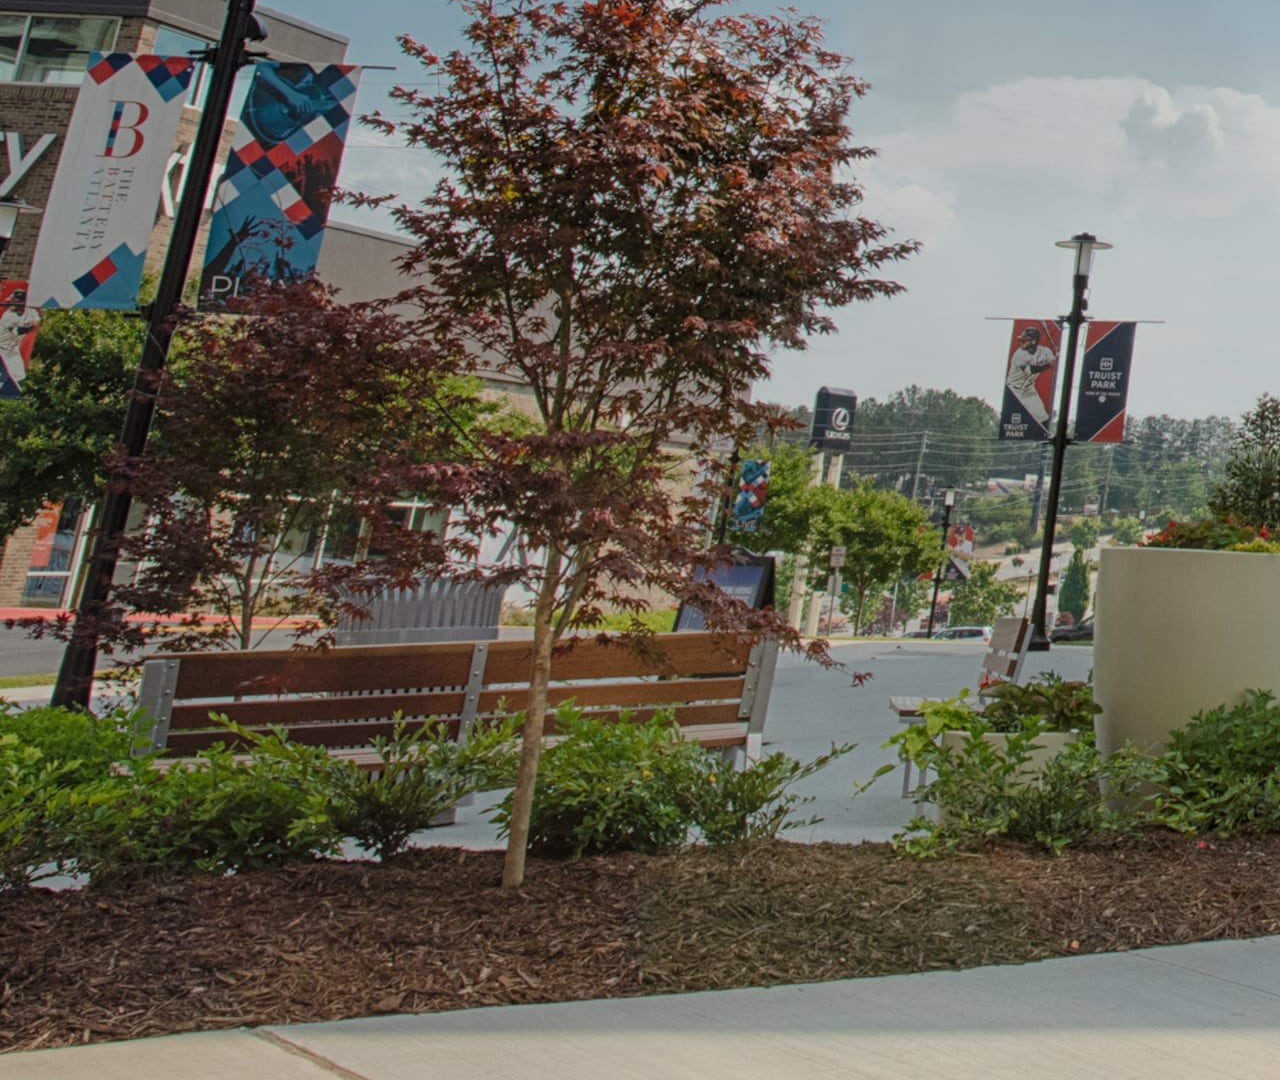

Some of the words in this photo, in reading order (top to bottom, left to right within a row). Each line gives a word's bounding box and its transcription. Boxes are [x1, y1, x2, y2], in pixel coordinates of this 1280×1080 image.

[95, 99, 149, 159] B
[115, 167, 135, 203] THE
[90, 167, 121, 250] BATTERY
[1088, 371, 1122, 380] TRUIST
[1091, 380, 1116, 389] PARK
